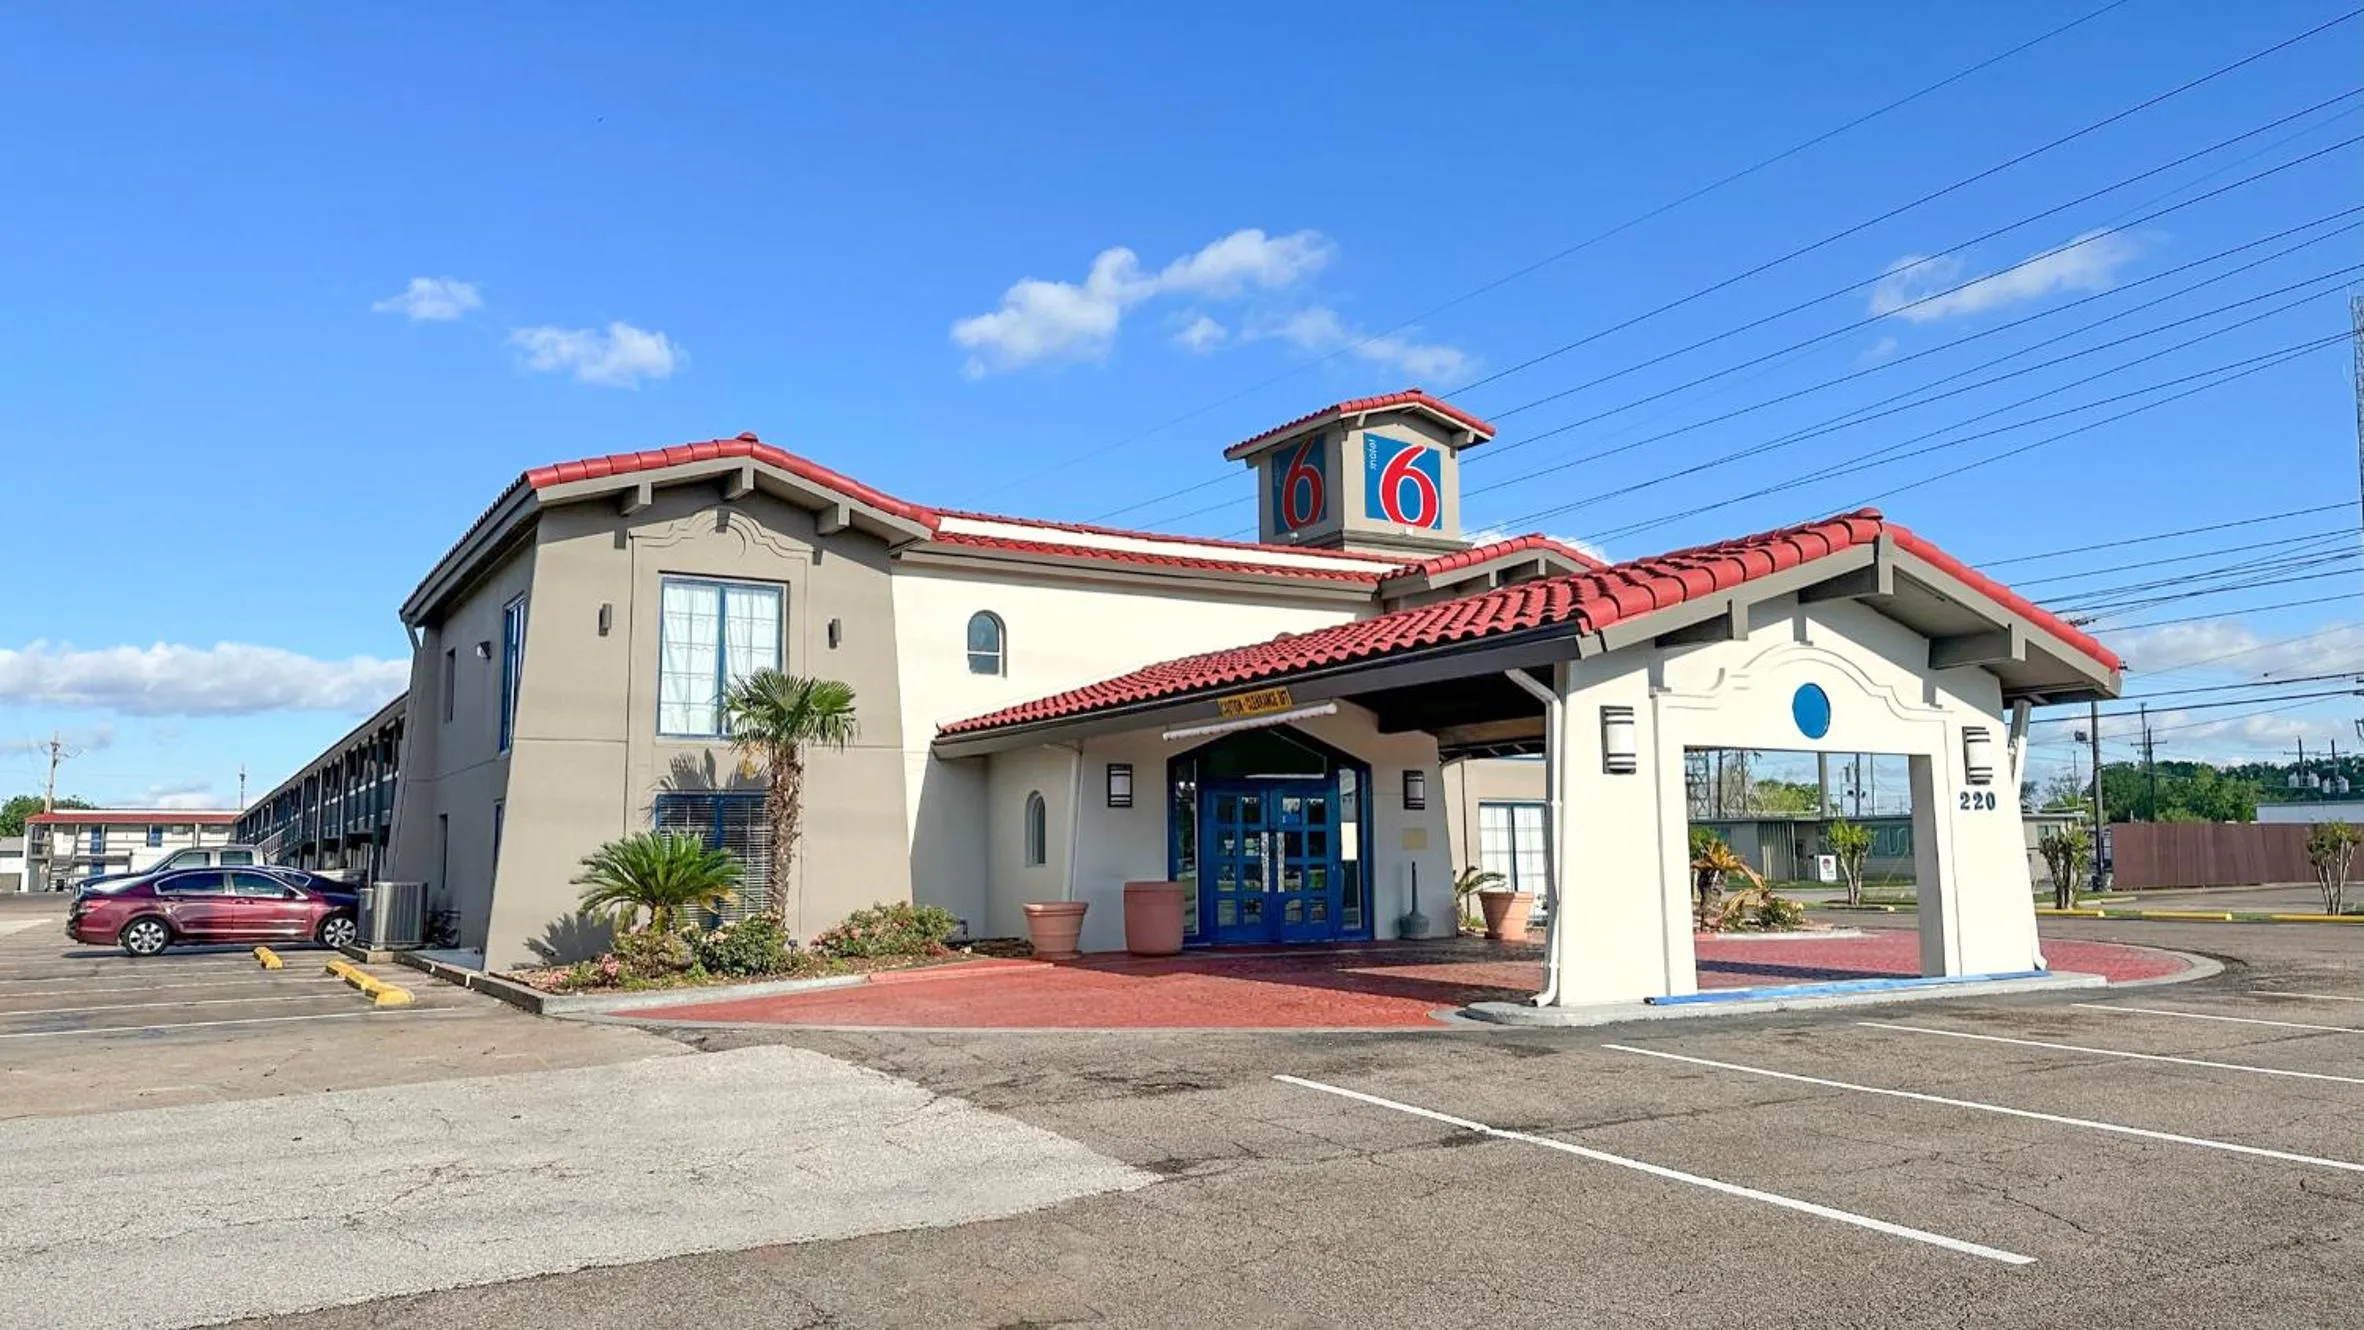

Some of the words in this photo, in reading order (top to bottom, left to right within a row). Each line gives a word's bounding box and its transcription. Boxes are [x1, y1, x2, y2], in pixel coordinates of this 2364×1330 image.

[1282, 437, 1326, 530] 6
[1379, 445, 1439, 529] 6
[1960, 791, 1996, 811] 220
